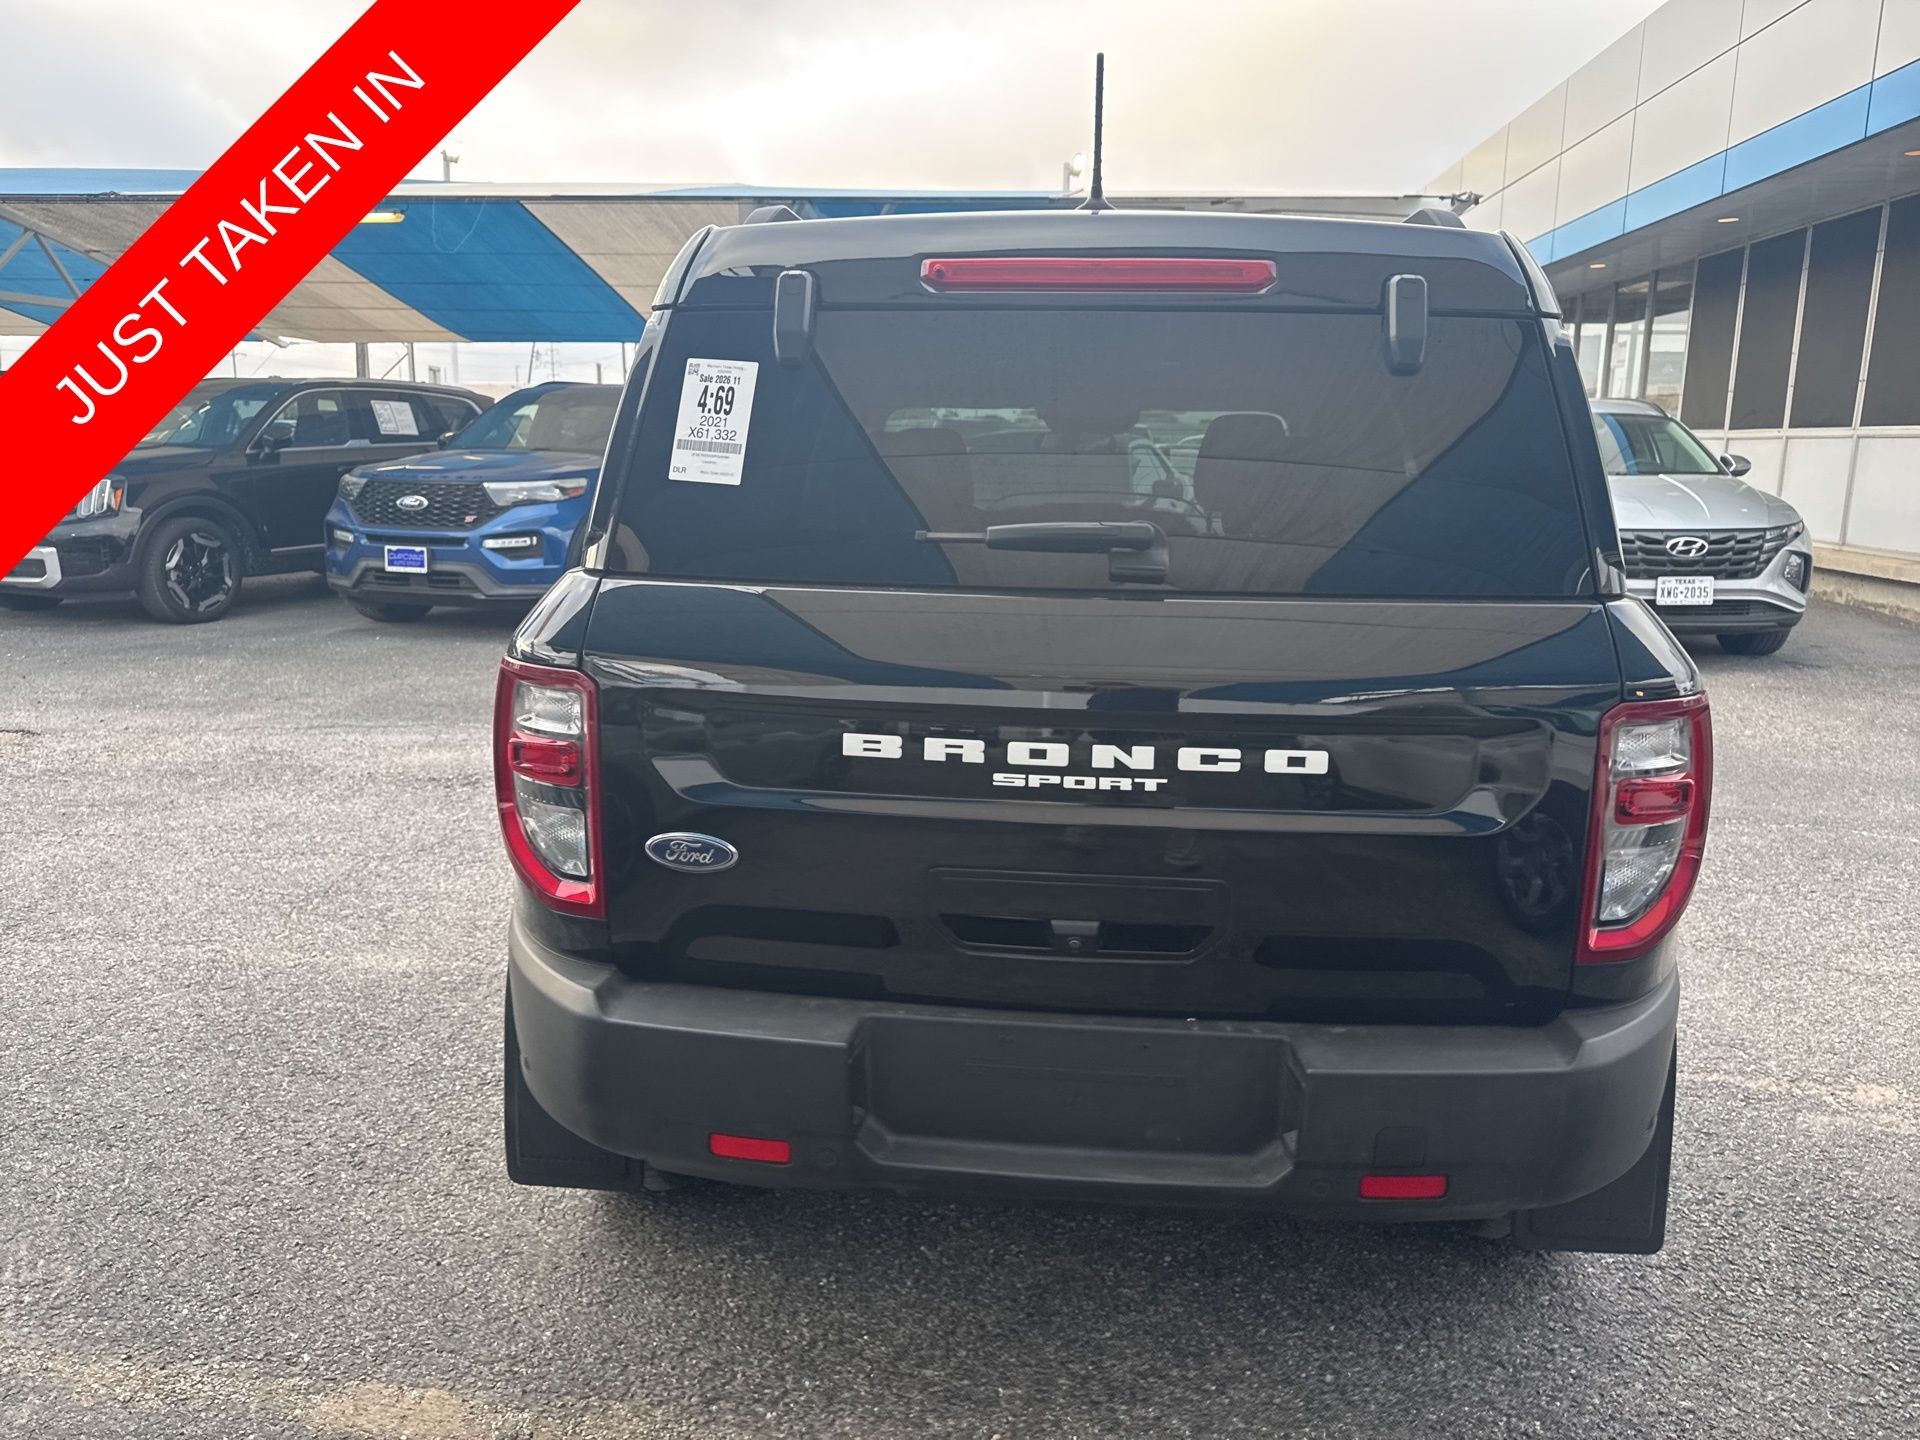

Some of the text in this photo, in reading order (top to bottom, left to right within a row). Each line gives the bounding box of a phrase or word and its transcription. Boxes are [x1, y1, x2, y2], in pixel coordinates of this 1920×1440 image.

[699, 373, 741, 385] Sale 2026 11
[697, 384, 735, 416] 4:69
[699, 415, 728, 428] 2021
[688, 427, 737, 441] X61,332
[672, 466, 687, 474] DLR
[842, 732, 1329, 775] BRONCO
[992, 772, 1168, 792] SPORT
[665, 840, 715, 864] Ford
